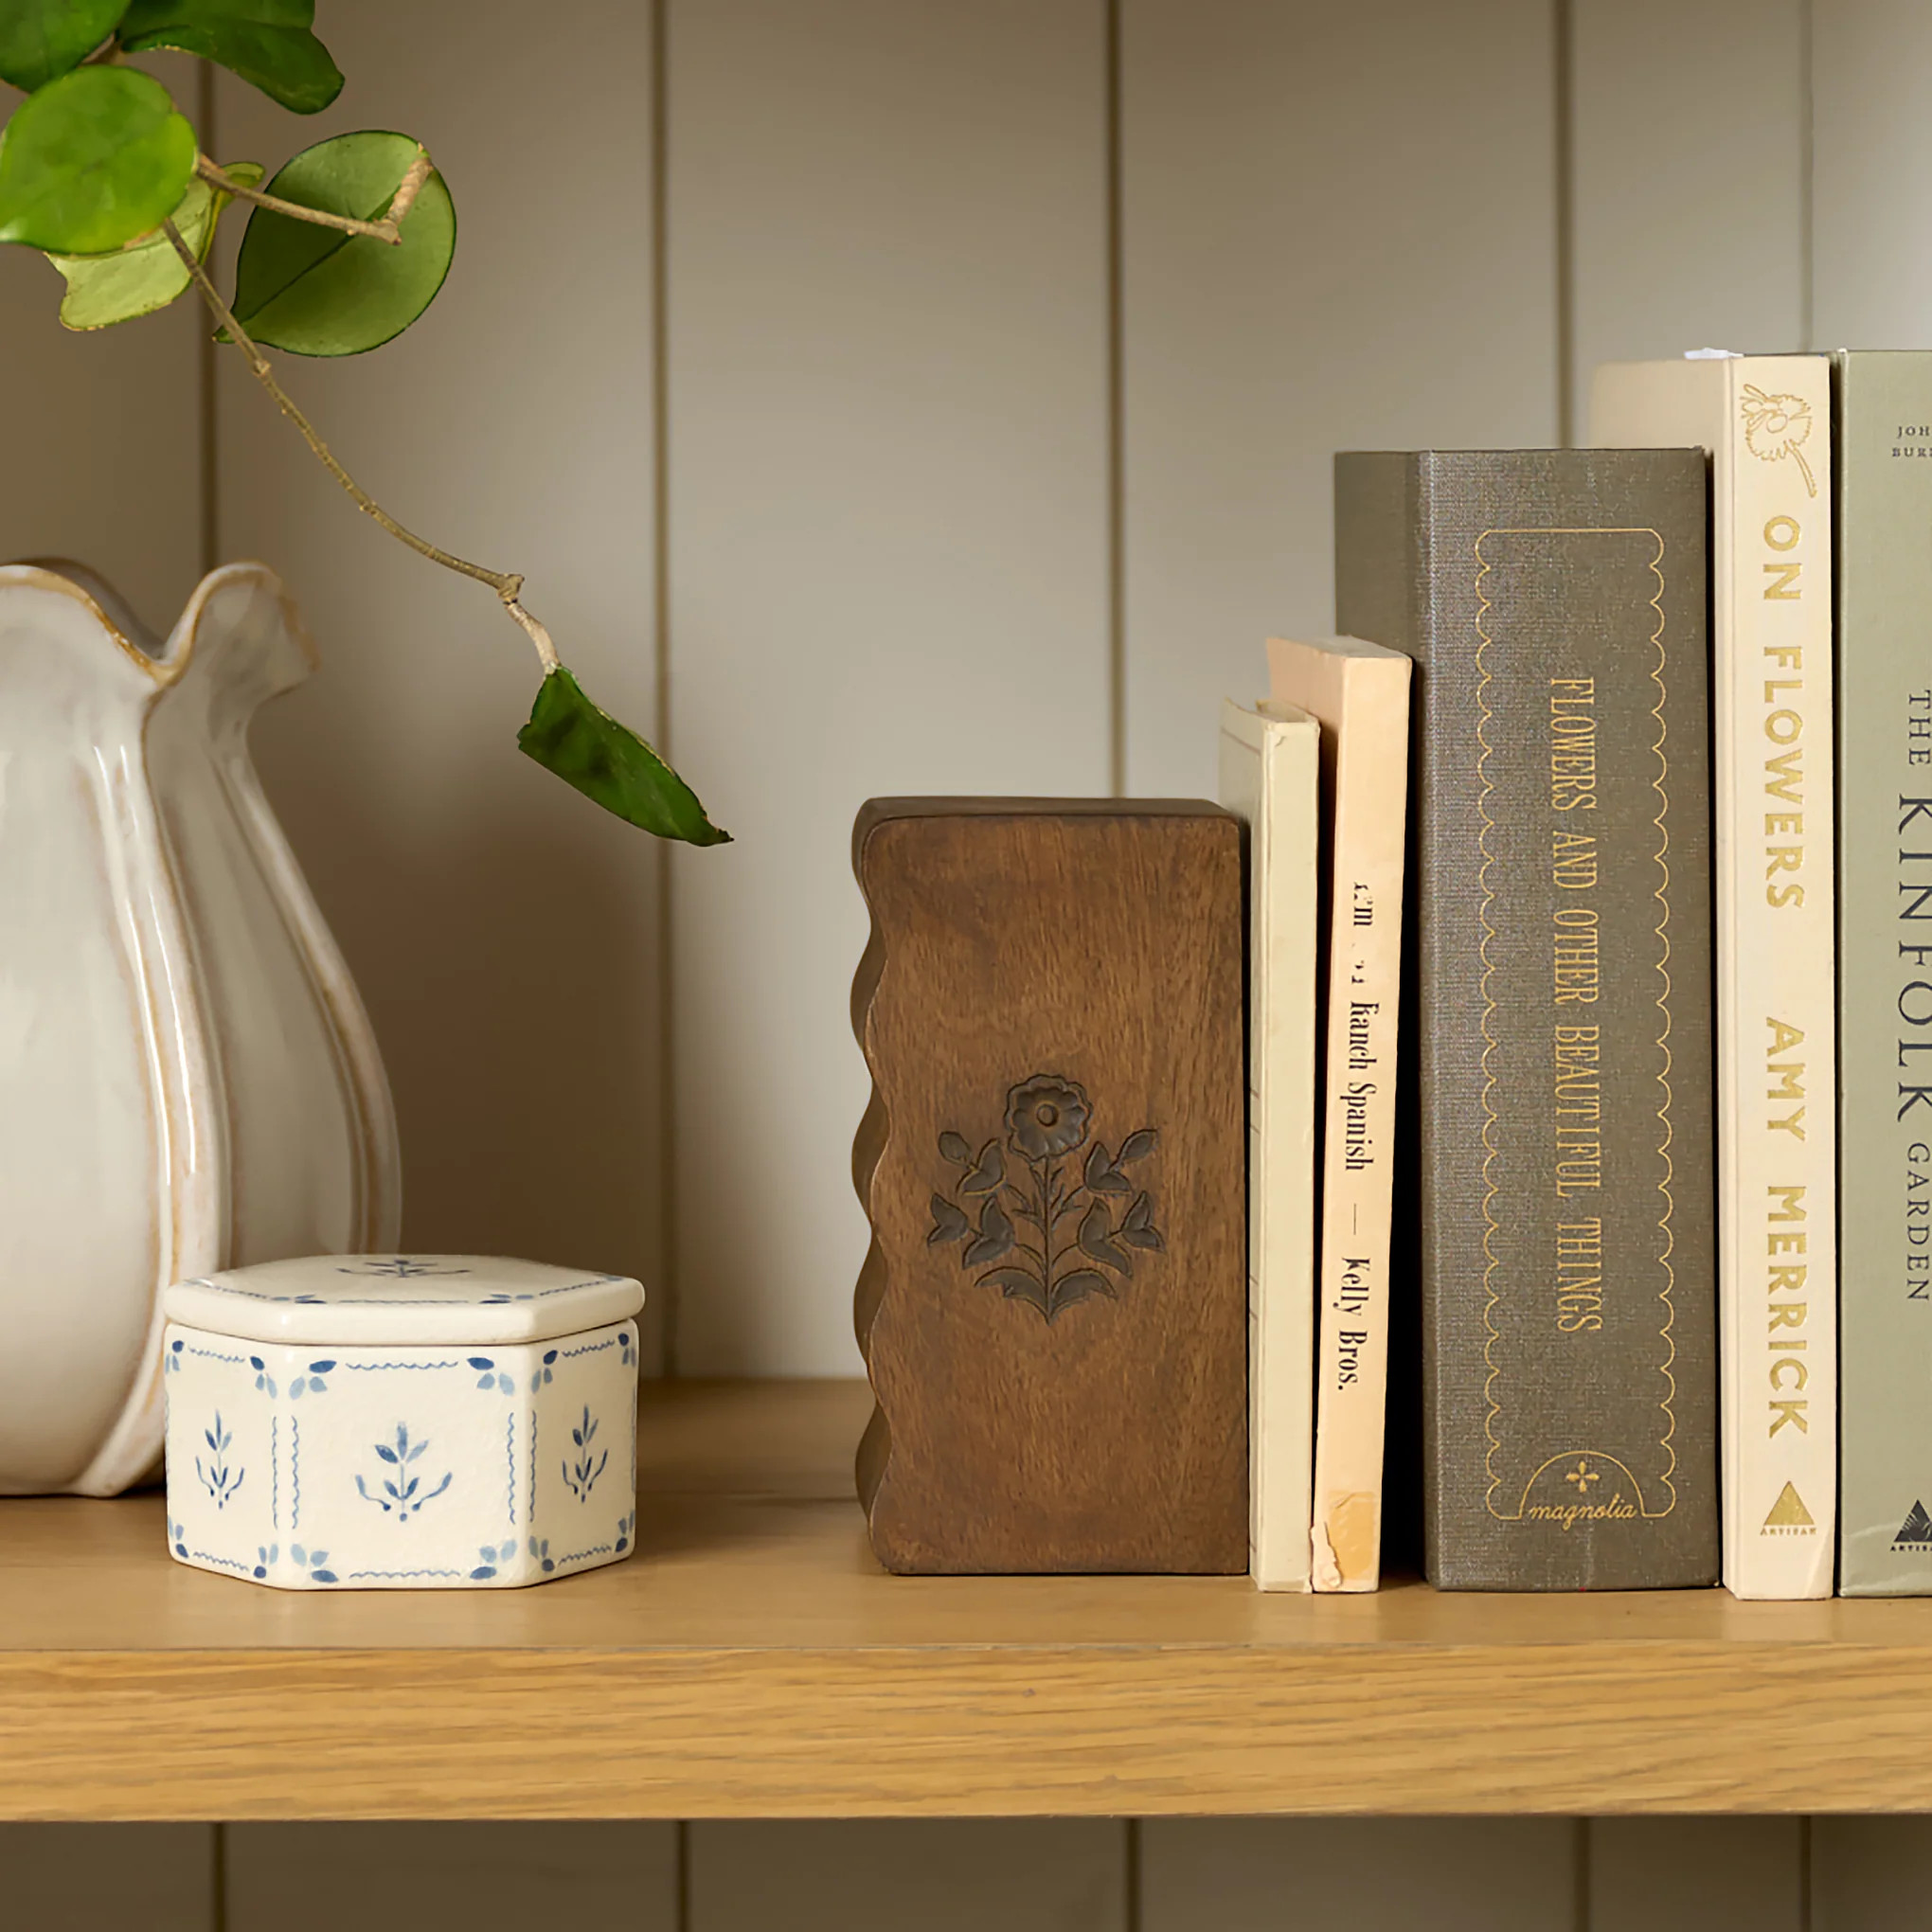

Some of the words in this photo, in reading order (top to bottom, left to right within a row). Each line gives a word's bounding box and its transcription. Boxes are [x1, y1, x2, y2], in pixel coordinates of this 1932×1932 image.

[1891, 447, 1932, 457] BUR
[1763, 516, 1801, 600] ON
[1550, 678, 1596, 812] FLOWERS
[1907, 689, 1932, 765] THE
[1764, 647, 1804, 907] FLOWERS
[1552, 832, 1597, 888] AND
[1553, 909, 1599, 1004] OTHER
[1898, 794, 1932, 1123] KINFOLK
[1555, 1025, 1601, 1197] BEAUTIFUL
[1766, 1017, 1806, 1141] AMY
[1339, 1081, 1377, 1172] Spanish
[1906, 1142, 1930, 1301] GARDEN
[1333, 1258, 1370, 1317] Kelly
[1557, 1217, 1602, 1333] THINGS
[1767, 1186, 1808, 1438] MERRICK
[1337, 1330, 1368, 1391] Bros.
[1528, 1493, 1638, 1530] magnolia
[1760, 1527, 1817, 1536] ARTISAN
